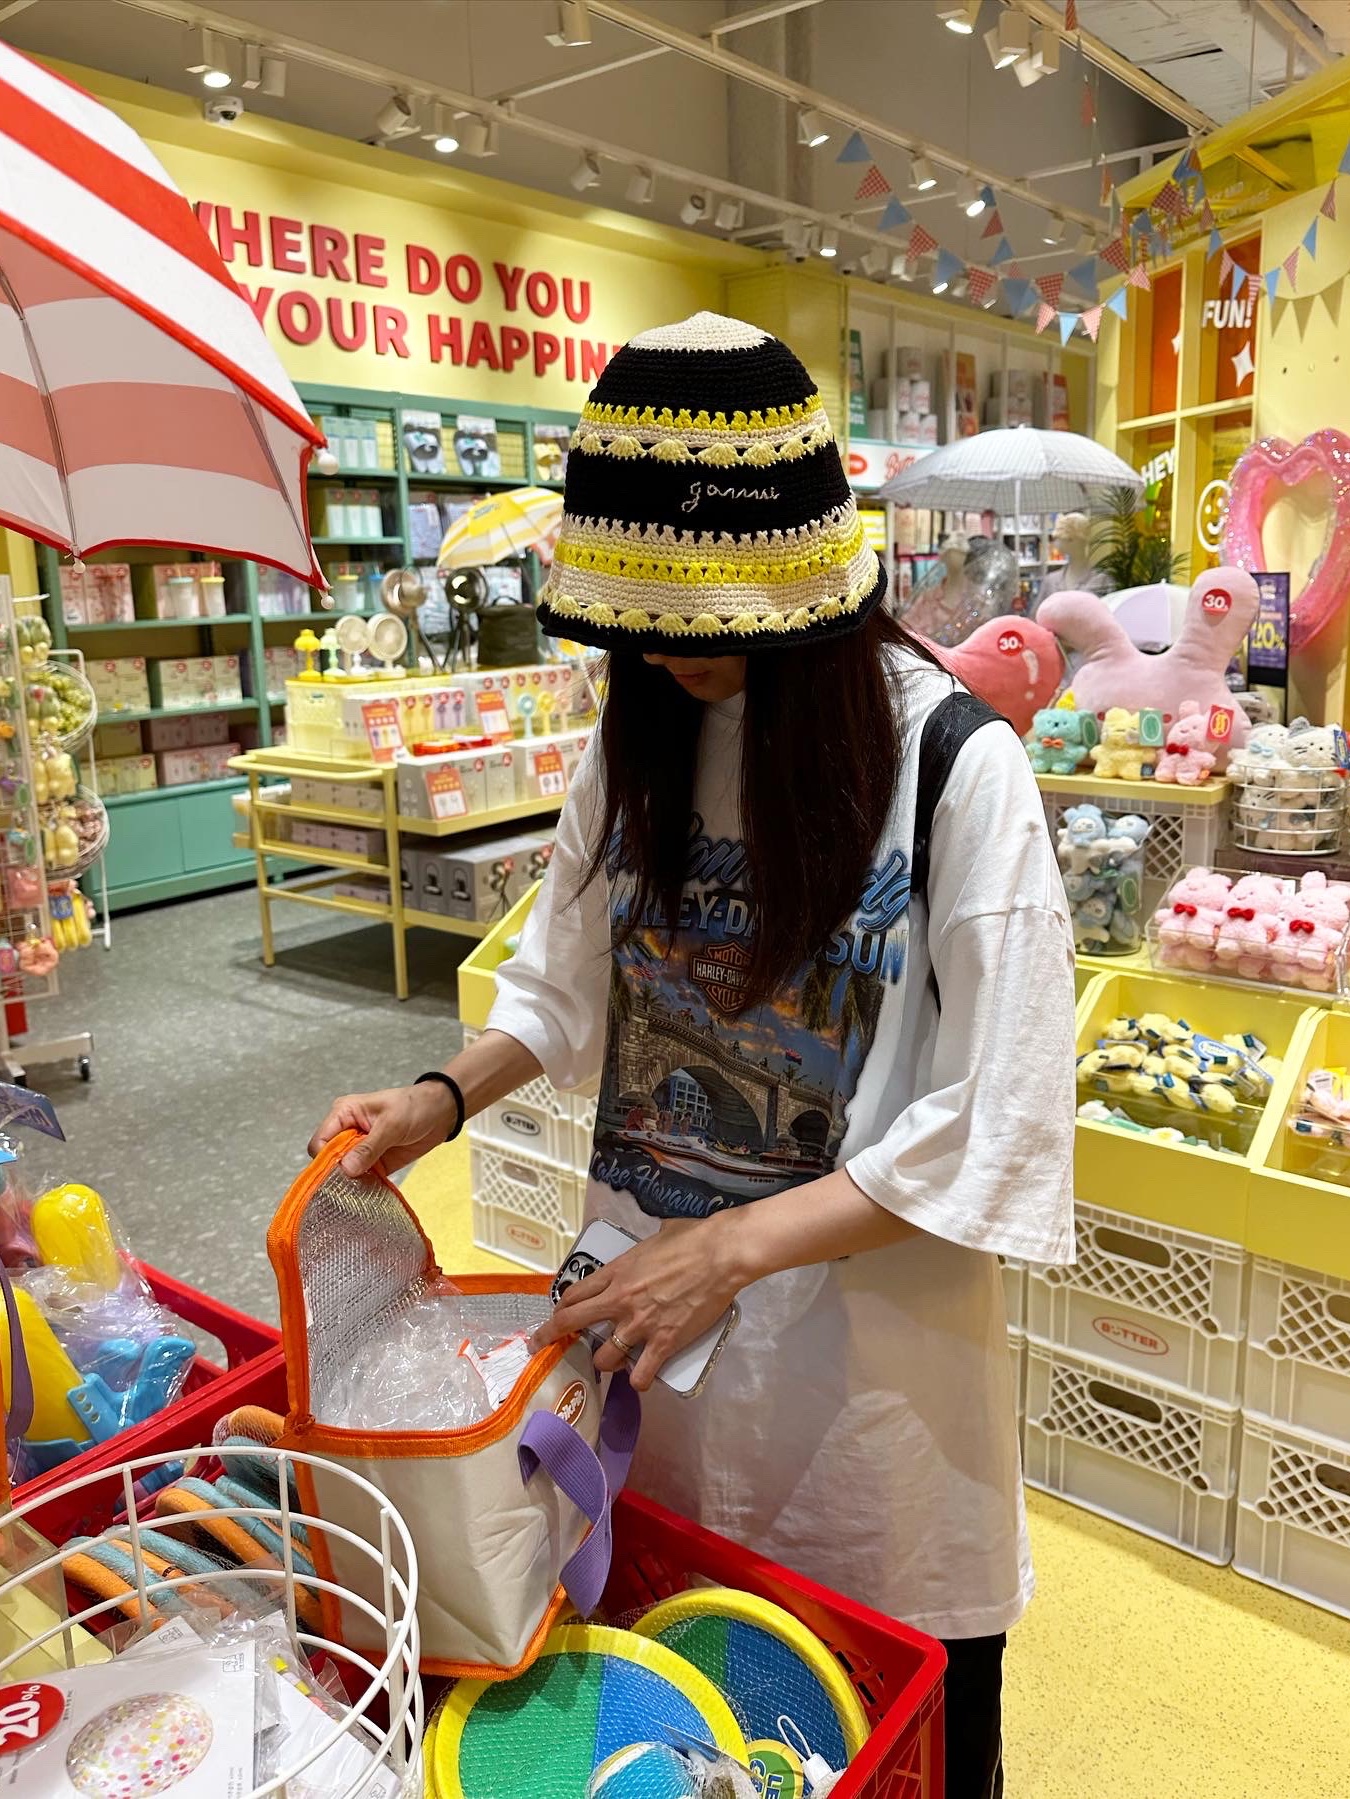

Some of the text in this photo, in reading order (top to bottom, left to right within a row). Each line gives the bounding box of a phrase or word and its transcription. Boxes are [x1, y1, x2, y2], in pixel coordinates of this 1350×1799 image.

[405, 244, 482, 304] DO
[493, 261, 591, 324] YOU
[1203, 300, 1253, 329] FUN!
[427, 313, 623, 383] HAPPIN
[0, 1684, 41, 1746] 20%
